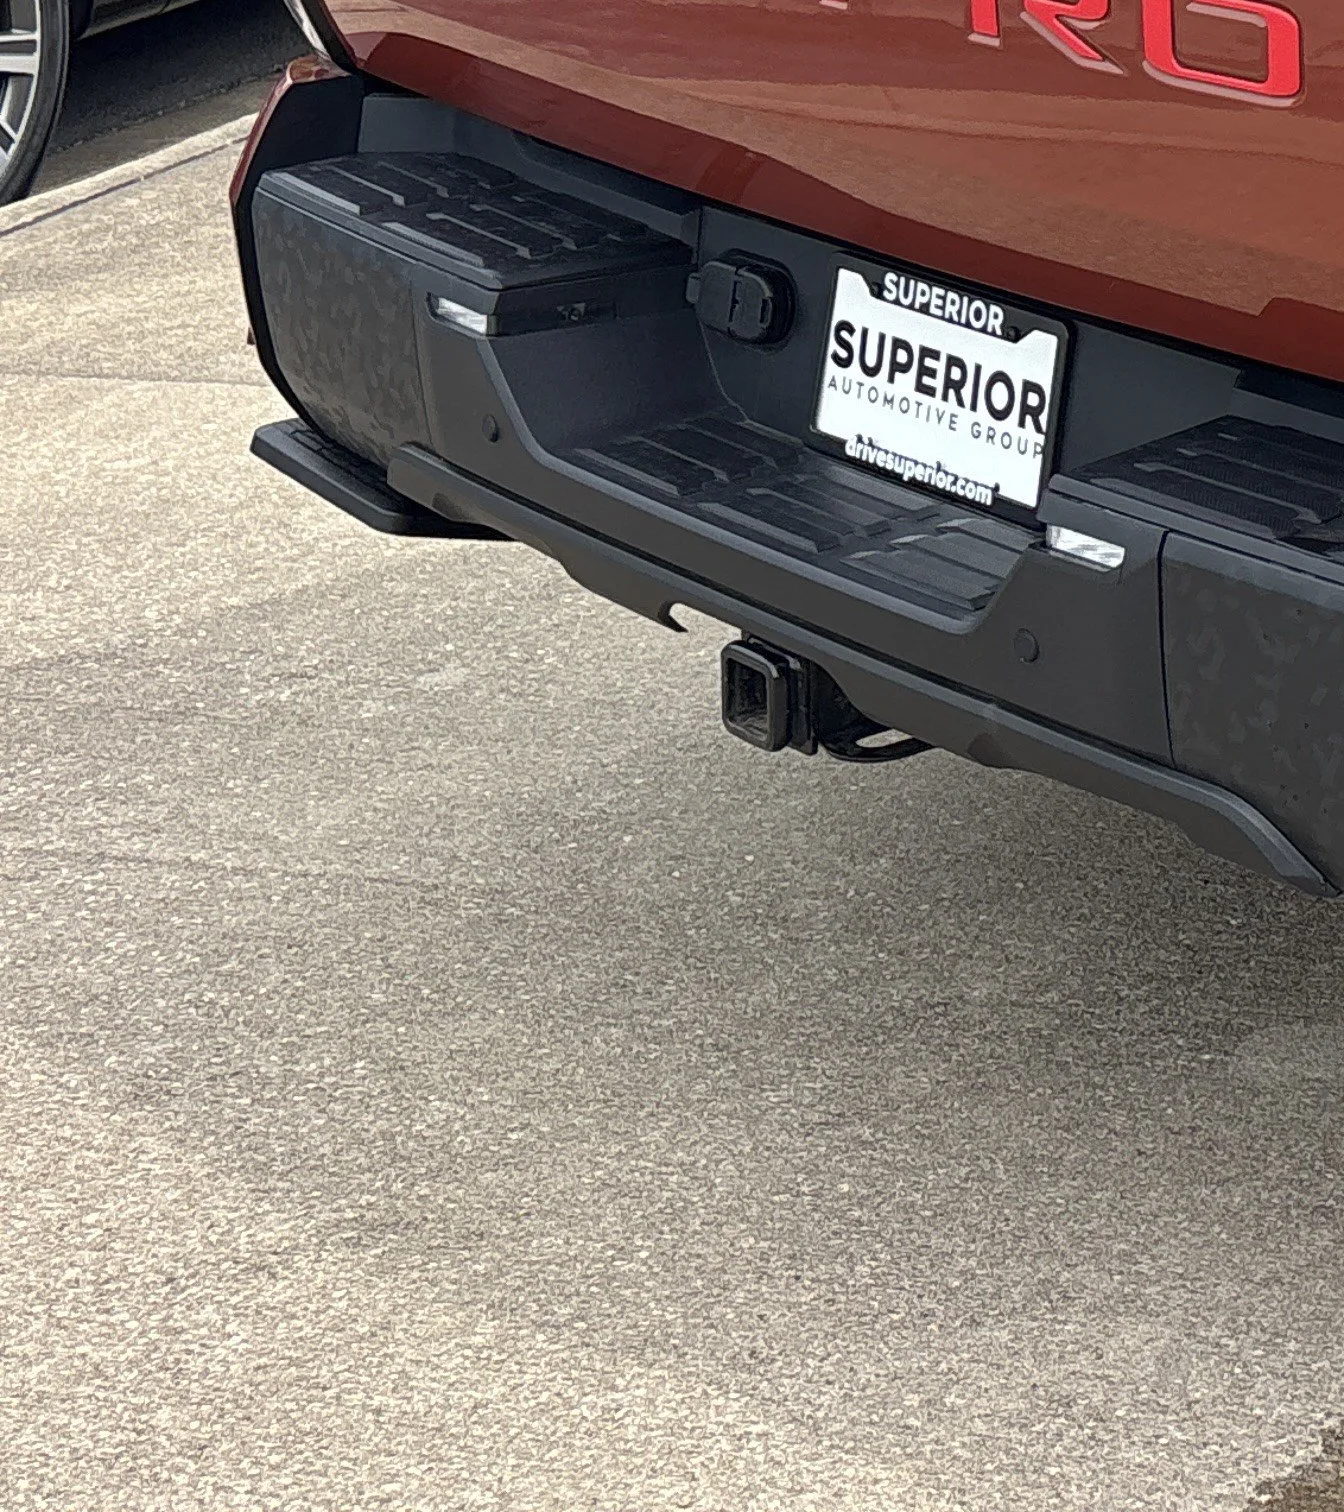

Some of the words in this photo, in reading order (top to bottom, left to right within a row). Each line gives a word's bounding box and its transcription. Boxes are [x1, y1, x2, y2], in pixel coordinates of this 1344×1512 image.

[882, 271, 1005, 336] SUPERIOR
[830, 319, 1046, 435] SUPERIOR
[827, 374, 959, 432] AUTOMOTIVE
[971, 421, 1044, 459] GROUP
[844, 435, 993, 506] drivesuperior.com
